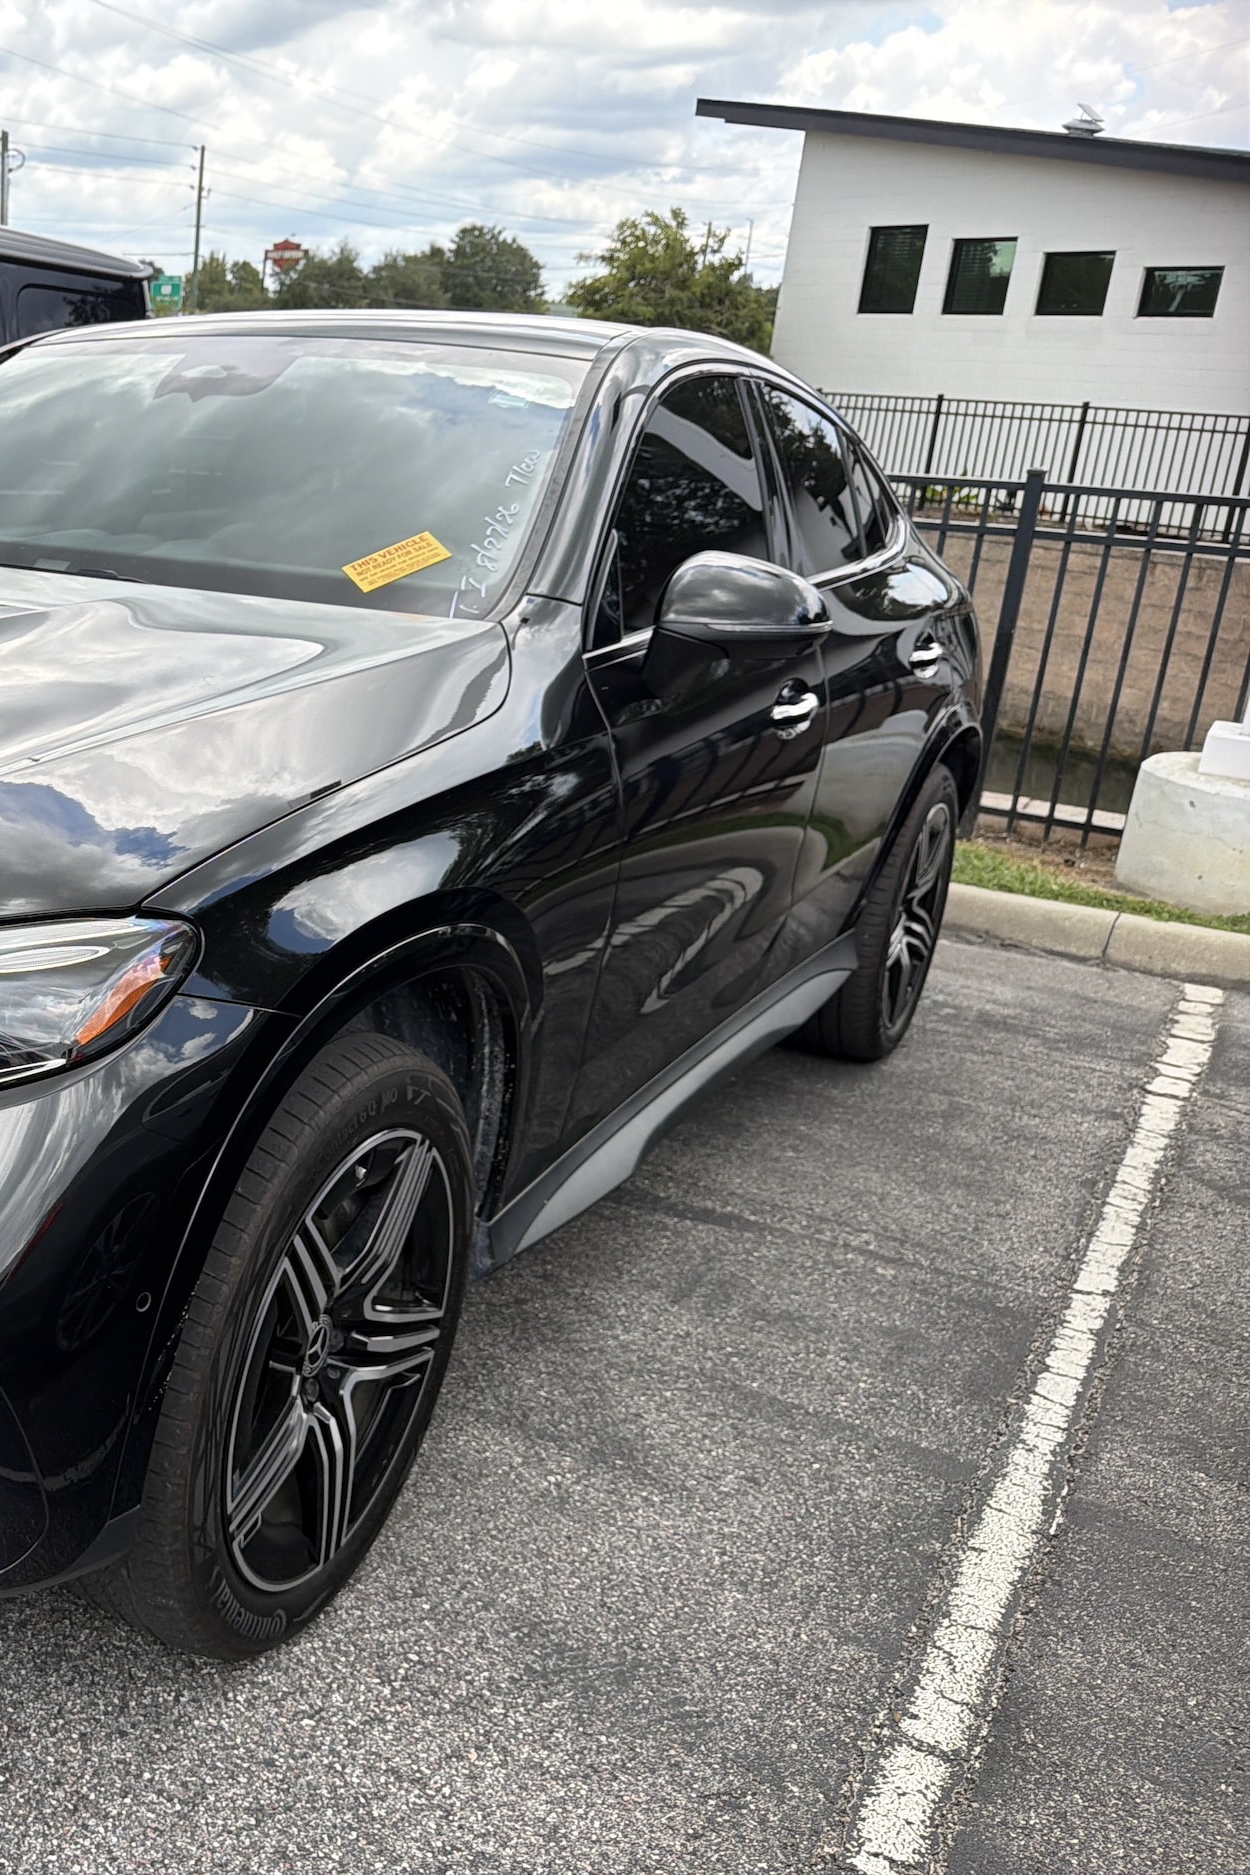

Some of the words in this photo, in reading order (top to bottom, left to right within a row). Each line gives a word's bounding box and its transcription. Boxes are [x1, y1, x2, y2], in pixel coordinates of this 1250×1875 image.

[349, 555, 378, 571] THIS
[377, 534, 428, 559] VEHICLE
[355, 566, 372, 576] NOT
[370, 556, 398, 570] READY
[396, 549, 413, 559] FOR
[412, 541, 433, 552] SALE
[209, 1576, 286, 1640] Continental
